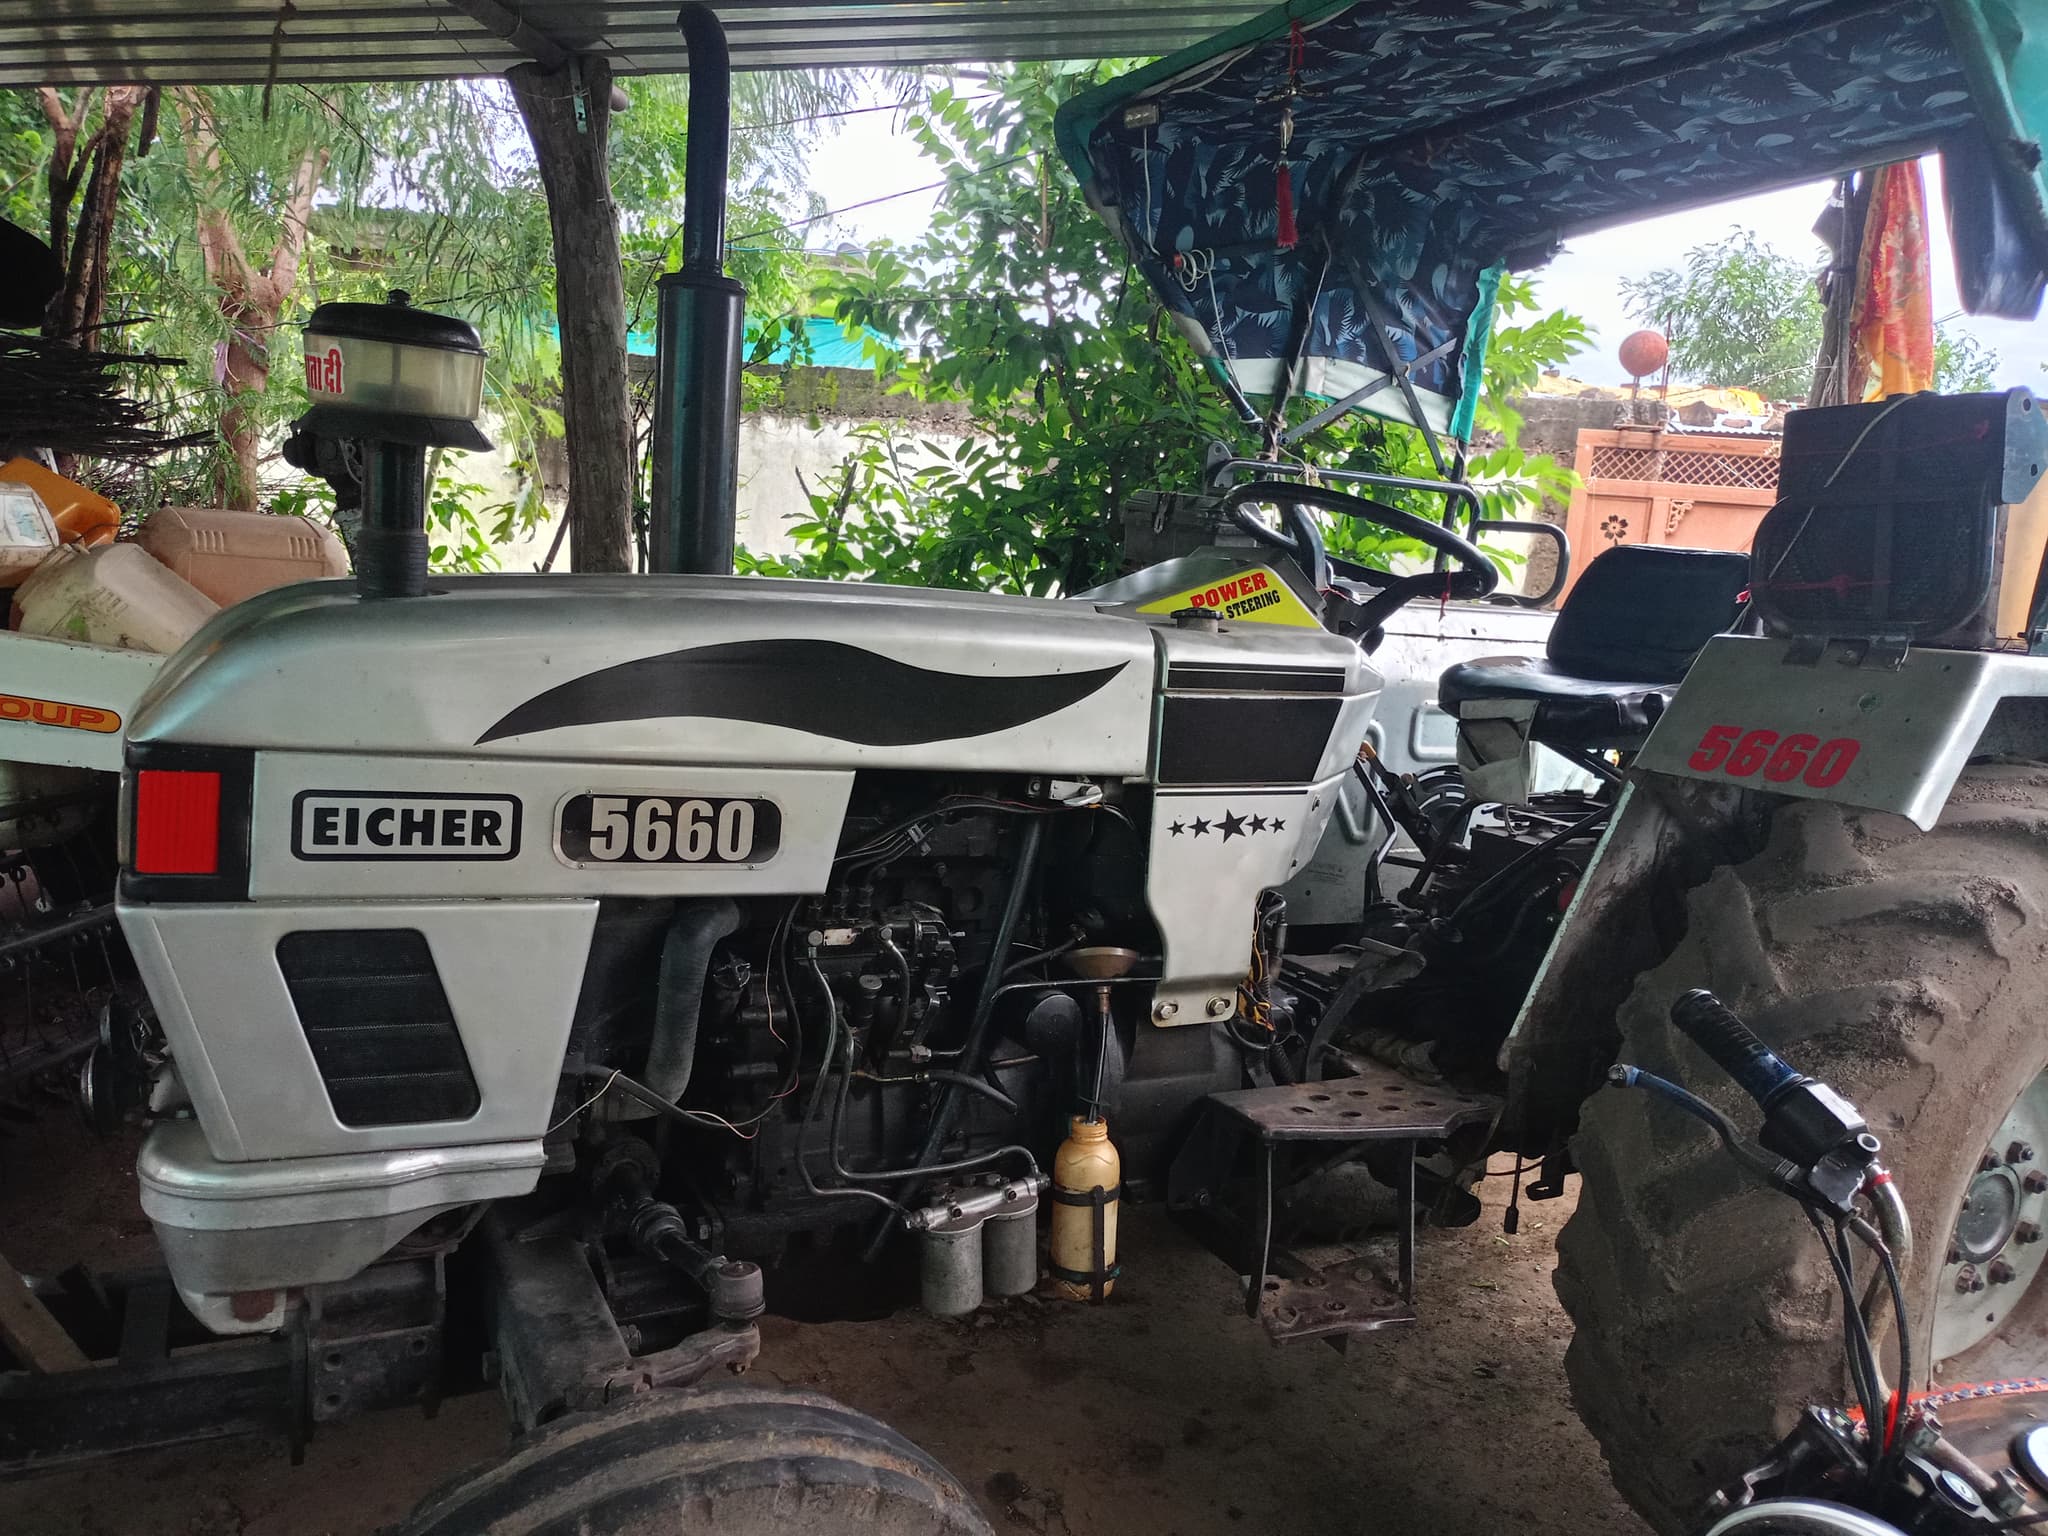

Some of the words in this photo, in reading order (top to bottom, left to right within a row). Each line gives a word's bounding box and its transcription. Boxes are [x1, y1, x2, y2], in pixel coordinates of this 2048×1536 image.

[1190, 572, 1268, 608] POWER
[1225, 590, 1281, 619] STEERING
[0, 697, 104, 727] OUP
[1687, 724, 1861, 789] 5660
[312, 807, 503, 847] EICHER
[588, 797, 755, 861] 5660
